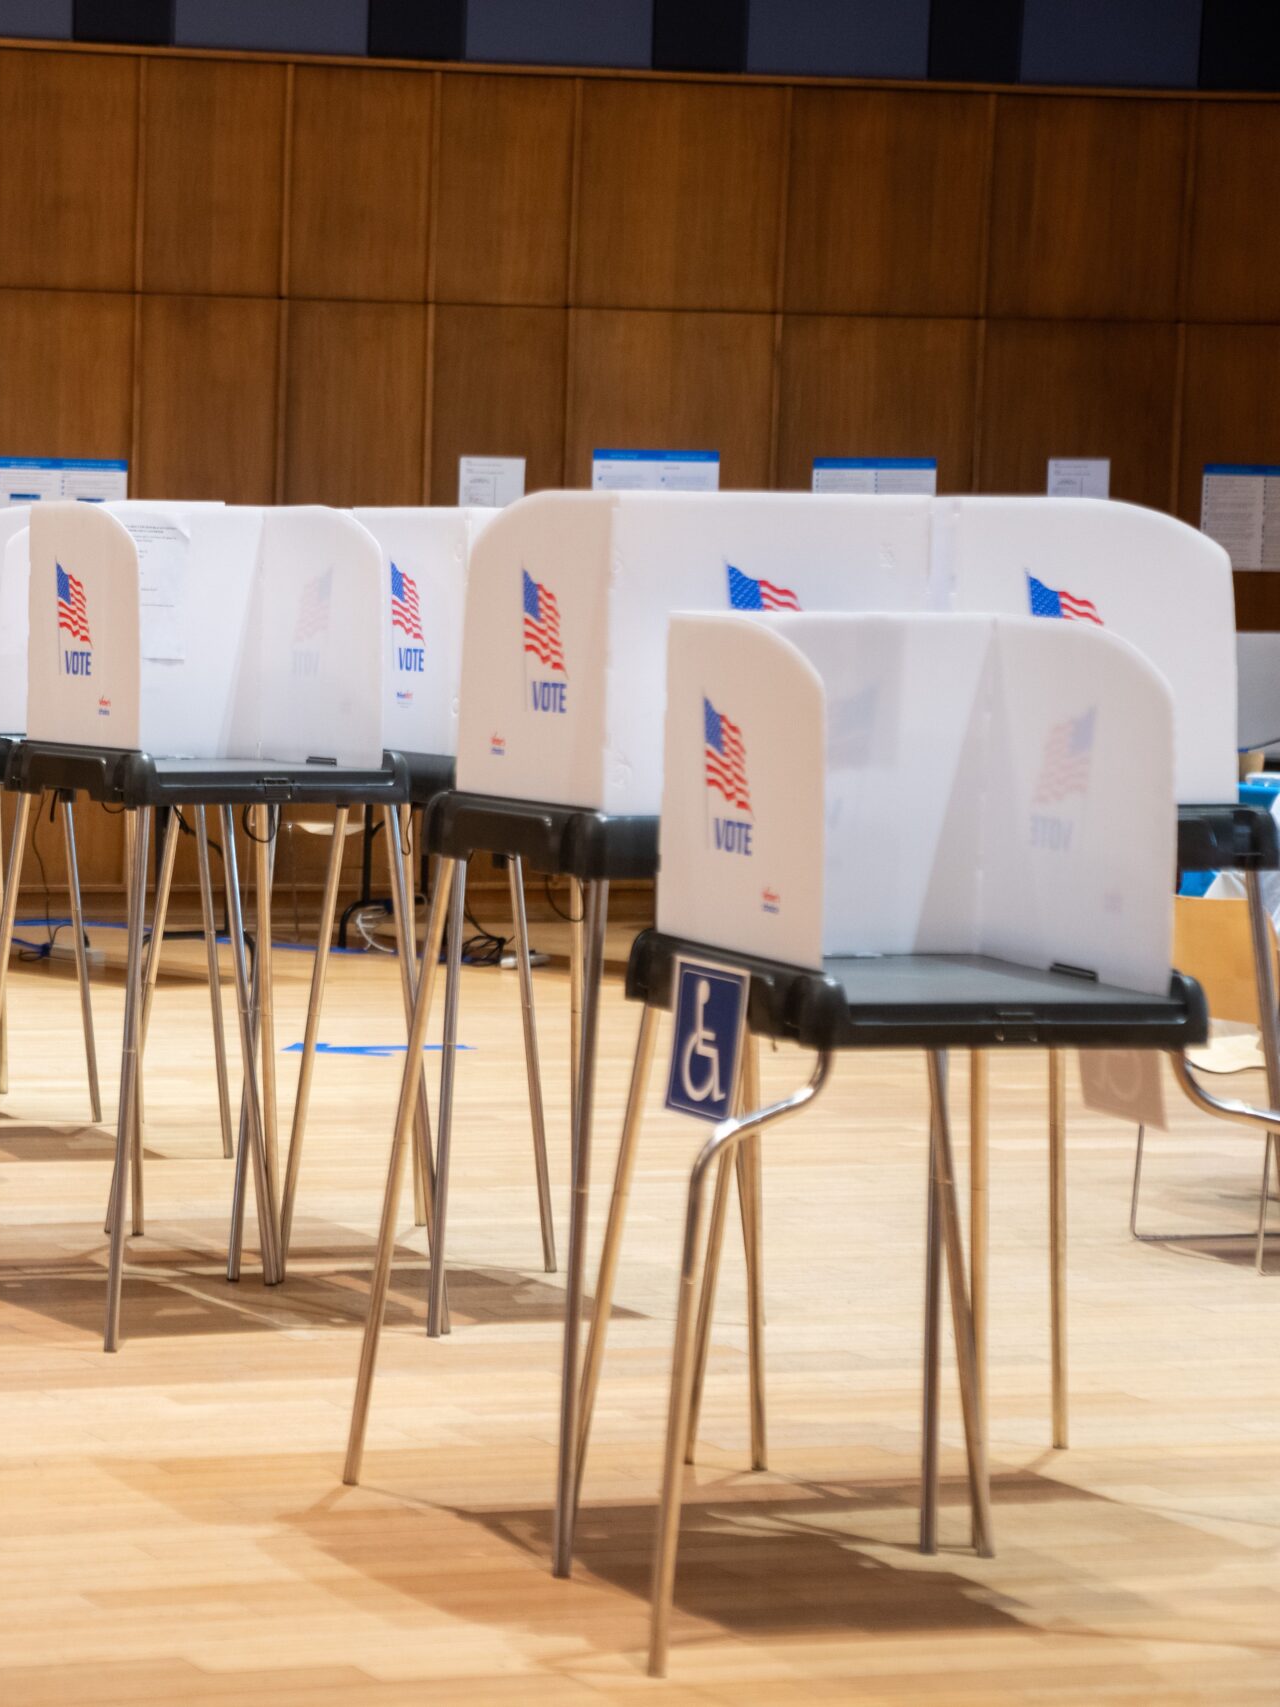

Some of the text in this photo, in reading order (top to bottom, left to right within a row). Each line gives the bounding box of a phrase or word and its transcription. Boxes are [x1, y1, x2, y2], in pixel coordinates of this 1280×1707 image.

[65, 650, 92, 676] VOTE
[398, 647, 425, 672] VOTE
[532, 680, 567, 713] VOTE
[714, 818, 753, 856] VOTE
